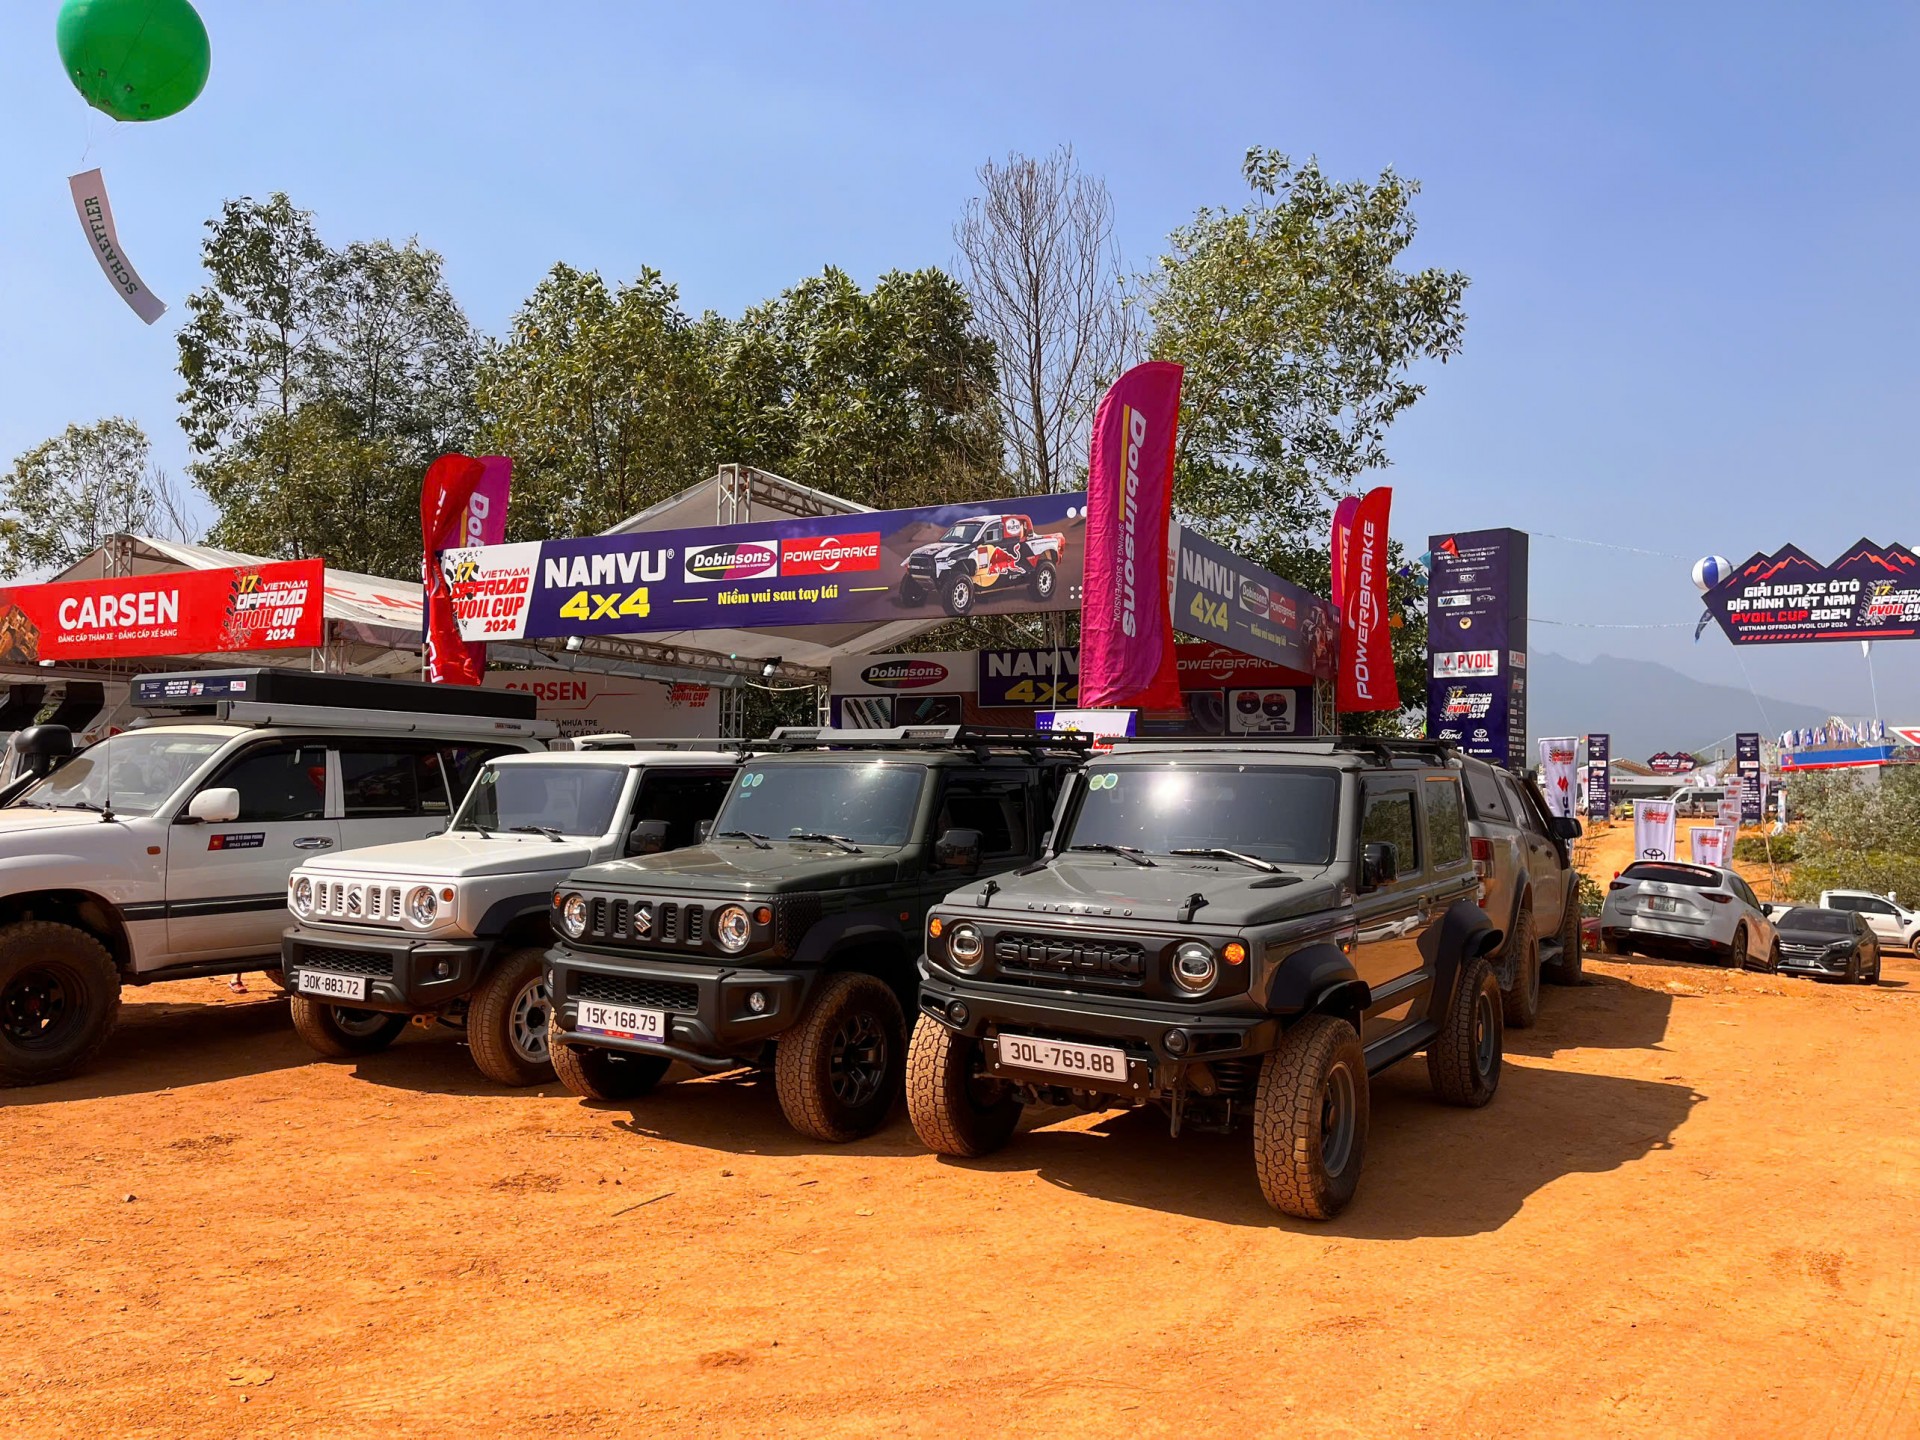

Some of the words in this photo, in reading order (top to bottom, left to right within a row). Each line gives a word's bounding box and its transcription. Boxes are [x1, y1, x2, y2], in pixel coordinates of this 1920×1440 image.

[84, 196, 138, 295] SCHAEFFLER
[1122, 408, 1147, 638] Dobinsons
[694, 551, 771, 568] Dobinsons
[783, 545, 878, 563] POWERBRAKE
[455, 562, 477, 581] 17
[480, 567, 530, 579] VIETNAM
[240, 575, 259, 593] 17
[263, 580, 309, 591] VIETNAM
[452, 577, 530, 600] OFFROAD
[1806, 582, 1827, 595] XE
[1875, 586, 1892, 596] 17
[236, 588, 308, 610] OFFROAD
[717, 588, 750, 605] Niềm
[751, 588, 771, 603] vui
[773, 590, 796, 602] sau
[798, 588, 819, 603] tay
[821, 584, 839, 599] lái
[1113, 565, 1123, 622] SUSPENSION
[1787, 595, 1820, 609] VIỆT
[1823, 594, 1856, 606] NAM
[58, 589, 179, 631] CARSEN
[492, 597, 526, 618] CUP
[1356, 519, 1375, 700] POWERBRAKE
[1730, 612, 1775, 624] PVOIL
[1777, 610, 1809, 622] CUP
[1810, 608, 1852, 621] 2024
[1868, 603, 1904, 617] PVOIL
[231, 608, 272, 631] PVOIL
[272, 607, 304, 627] CUP
[483, 619, 517, 633] 2024
[1767, 623, 1797, 631] OFFROAD
[265, 628, 296, 641] 2024
[1458, 653, 1494, 669] PVOIL
[869, 665, 943, 678] Dobinsons
[692, 692, 709, 701] CUP
[1449, 697, 1492, 705] OFFROAD
[1447, 704, 1472, 713] PVOIL
[1471, 704, 1490, 713] CUP
[1439, 729, 1463, 740] Ford
[994, 942, 1142, 975] SUZUKI
[303, 974, 359, 996] 30K-883.72
[586, 1006, 657, 1032] 15K-168.79
[1010, 1042, 1115, 1074] 30L-769.88
